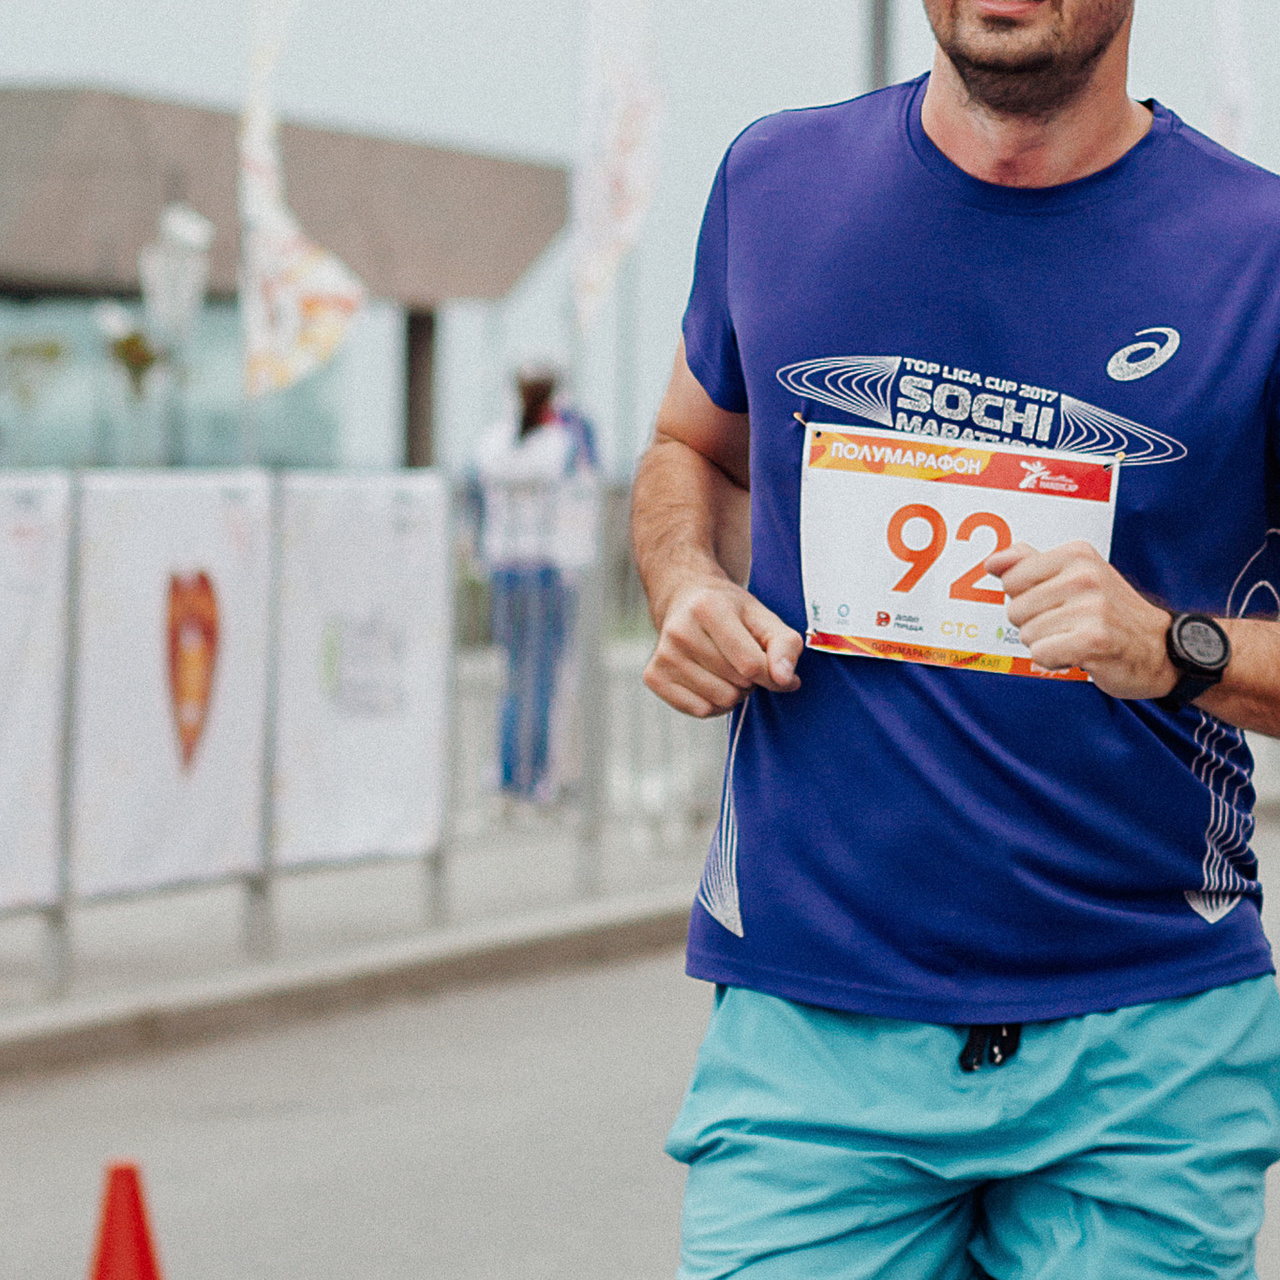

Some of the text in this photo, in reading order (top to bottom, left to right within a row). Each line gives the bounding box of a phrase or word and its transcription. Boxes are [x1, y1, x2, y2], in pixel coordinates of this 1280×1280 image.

[903, 357, 1059, 403] TOP LIGA CUP 2017
[896, 375, 1055, 442] SOCHI
[895, 412, 1050, 451] MARAT
[830, 441, 983, 476] ПОЛУМАРАФОН
[887, 503, 1012, 605] 92
[871, 642, 946, 662] ПОЛУМАРАФОН
